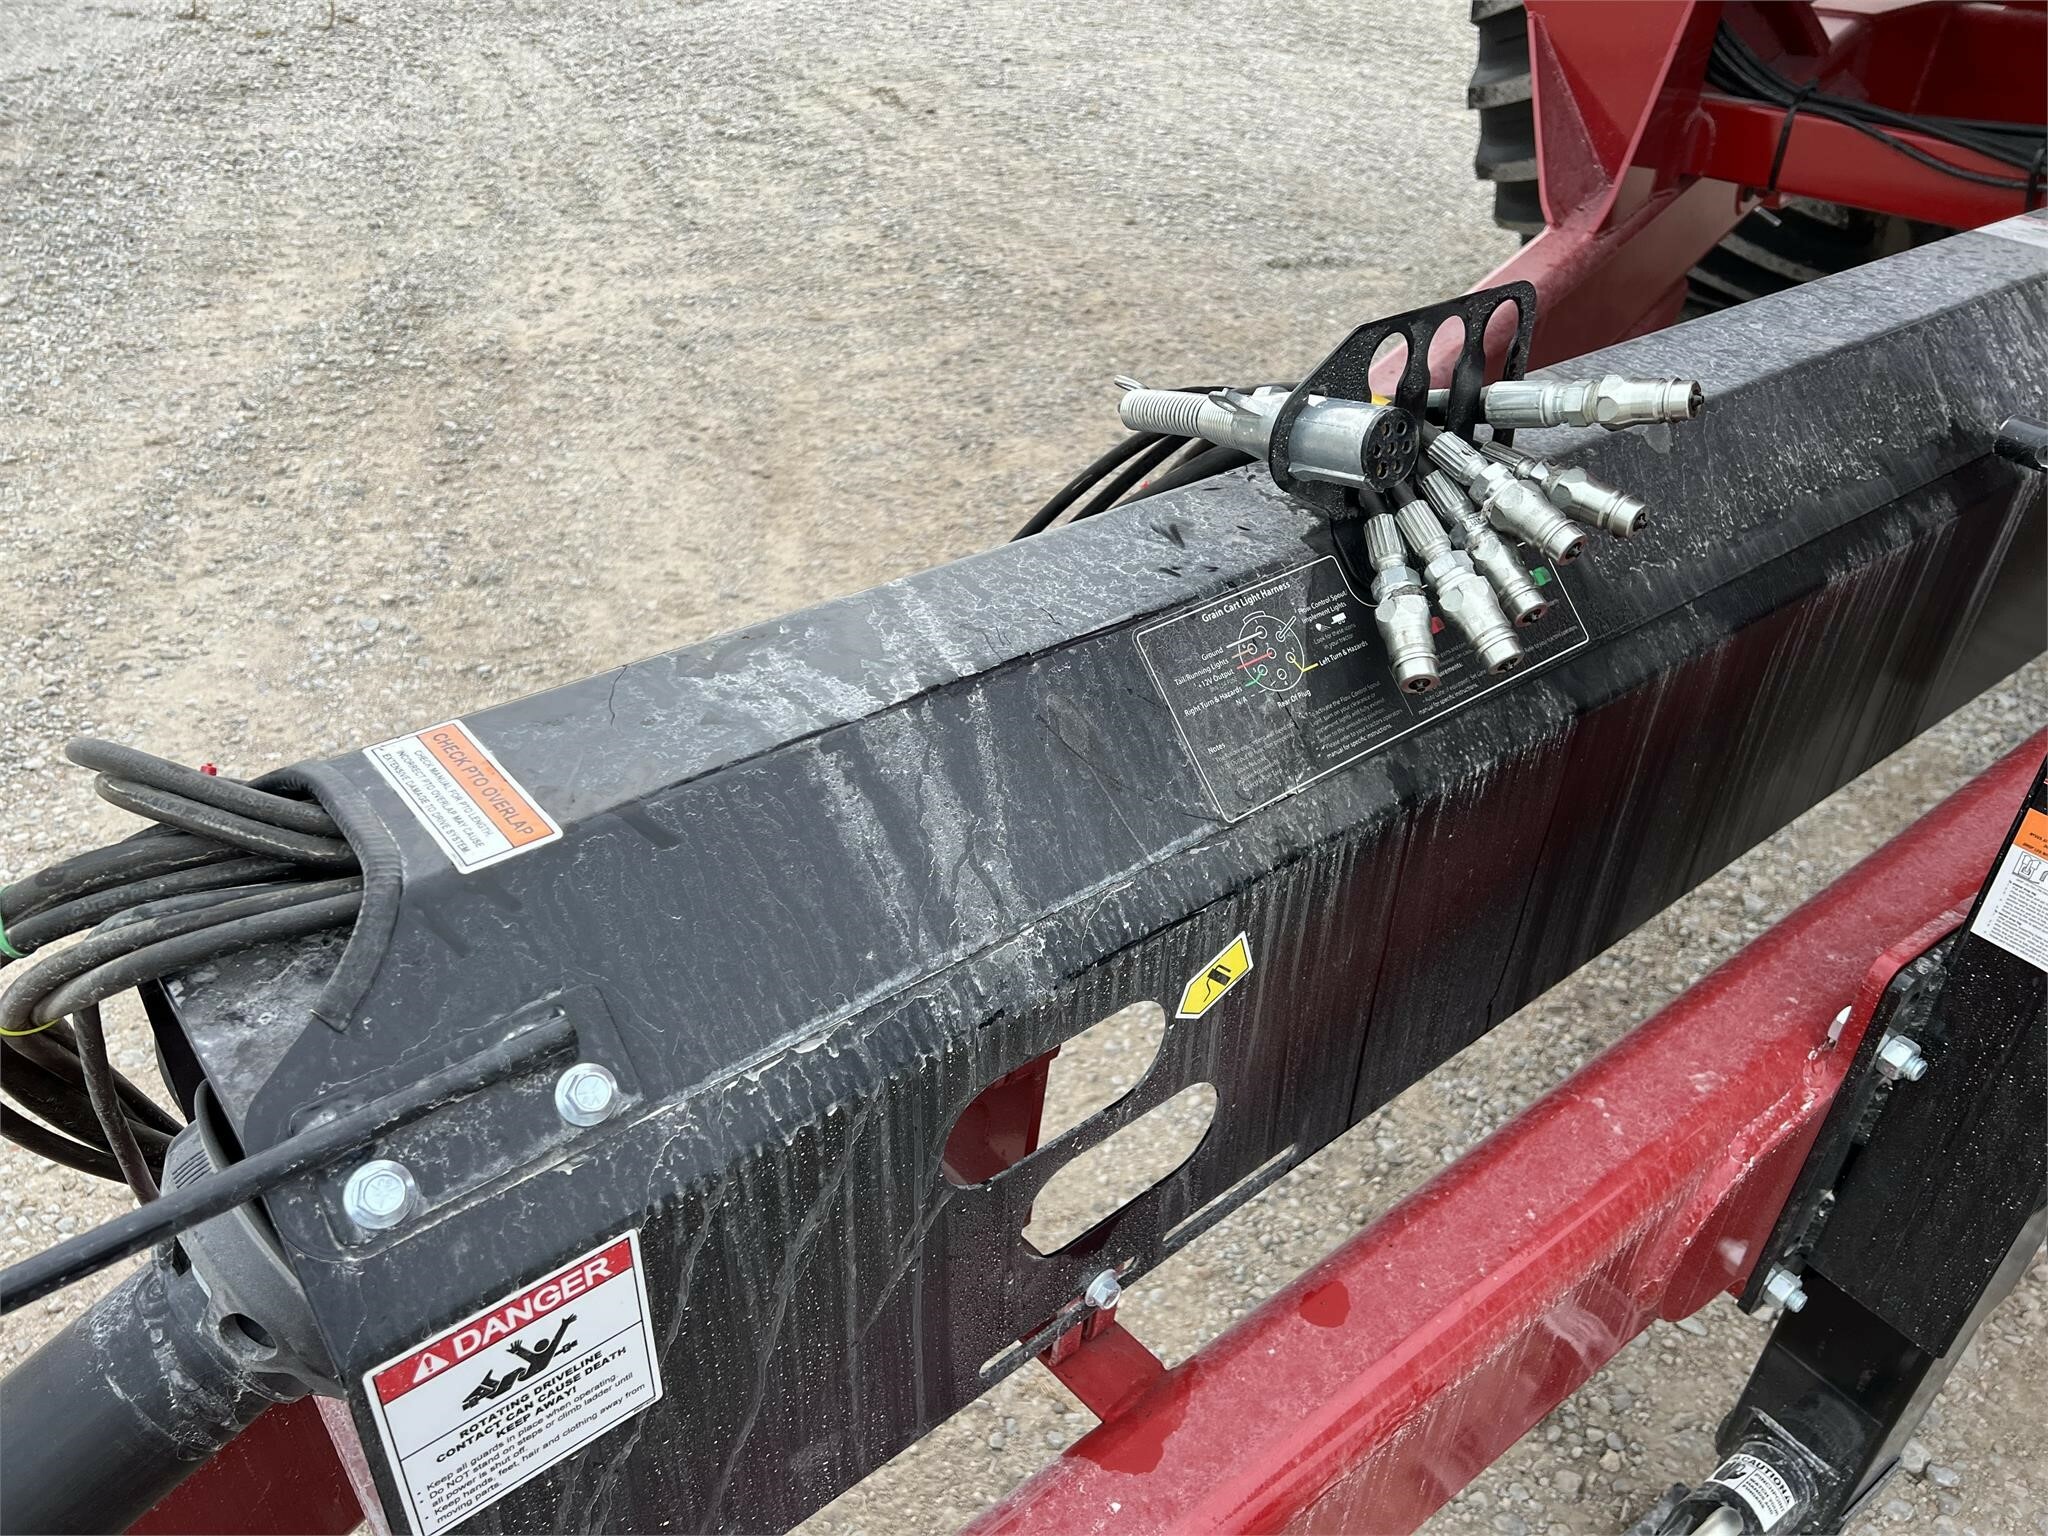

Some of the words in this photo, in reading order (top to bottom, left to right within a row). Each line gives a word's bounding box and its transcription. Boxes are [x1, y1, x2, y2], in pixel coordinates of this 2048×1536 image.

[1200, 608, 1224, 622] Grain
[1222, 600, 1241, 613] Cart
[1239, 592, 1261, 607] Light
[1259, 580, 1291, 598] Harness
[1301, 607, 1331, 626] Implement
[1329, 599, 1347, 613] Lights
[1309, 596, 1330, 610] Control
[1200, 645, 1224, 661] Ground
[1209, 656, 1230, 671] Lights
[1318, 655, 1332, 667] Left
[1329, 650, 1343, 662] Turn
[1341, 648, 1348, 656] &
[1346, 638, 1369, 654] Hazards
[1211, 666, 1235, 683] Output
[1183, 703, 1202, 719] Right
[1199, 697, 1214, 709] Turn
[1212, 694, 1220, 703] &
[1218, 684, 1243, 701] Hazards
[1234, 695, 1248, 706] N/A
[1276, 696, 1291, 709] Rear
[1289, 692, 1299, 702] Of
[1296, 686, 1312, 701] Plug
[1206, 742, 1226, 755] Notes
[380, 752, 411, 781] EXTENSIVE
[432, 732, 472, 767] CHECK
[460, 764, 489, 787] PTO
[480, 786, 534, 834] OVERLAP
[394, 749, 427, 779] INCORRECT
[419, 777, 436, 791] PTO
[428, 789, 458, 816] OVERLAP
[450, 814, 468, 828] MAY
[460, 826, 485, 849] CAUSE
[403, 779, 431, 805] DAMAGE
[411, 749, 435, 769] CHECK
[426, 766, 453, 790] MANUAL
[446, 788, 464, 802] FOR
[456, 800, 474, 814] PTO
[465, 811, 495, 837] LENGTH
[423, 802, 438, 813] TO
[429, 810, 452, 830] DRIVE
[444, 828, 472, 854] SYSTEM
[453, 1257, 610, 1357] DANGER
[435, 1418, 501, 1463] CONTACT
[505, 1400, 534, 1421] CAN
[537, 1372, 581, 1403] CAUSE
[583, 1346, 626, 1375] DEATH
[459, 1393, 530, 1439] ROTATING
[533, 1350, 602, 1395] DRIVELINE
[495, 1412, 531, 1438] KEEP
[534, 1385, 576, 1416] AWAY!
[425, 1471, 454, 1491] Keep
[455, 1461, 468, 1474] all
[469, 1441, 504, 1466] guards
[505, 1434, 516, 1443] in
[517, 1417, 544, 1438] place
[545, 1400, 572, 1419] when
[572, 1373, 616, 1403] operating.
[428, 1486, 444, 1500] Do
[445, 1468, 470, 1489] NOT
[471, 1451, 500, 1473] stand
[501, 1443, 515, 1455] on
[516, 1427, 543, 1446] steps
[544, 1418, 555, 1429] or
[556, 1403, 582, 1422] climb
[583, 1384, 612, 1406] ladder
[613, 1371, 633, 1387] until
[433, 1496, 461, 1515] Keep
[462, 1476, 495, 1498] hands,
[497, 1460, 520, 1476] feet,
[521, 1446, 540, 1462] hair
[541, 1433, 560, 1449] and
[561, 1411, 598, 1437] clothing
[599, 1396, 623, 1414] away
[624, 1383, 645, 1399] from
[431, 1495, 444, 1508] all
[445, 1476, 476, 1500] power
[478, 1470, 488, 1479] is
[489, 1455, 511, 1472] shut
[512, 1445, 528, 1458] off.
[1742, 1456, 1786, 1494] CAUTION
[436, 1498, 473, 1523] moving
[474, 1481, 502, 1501] parts.
